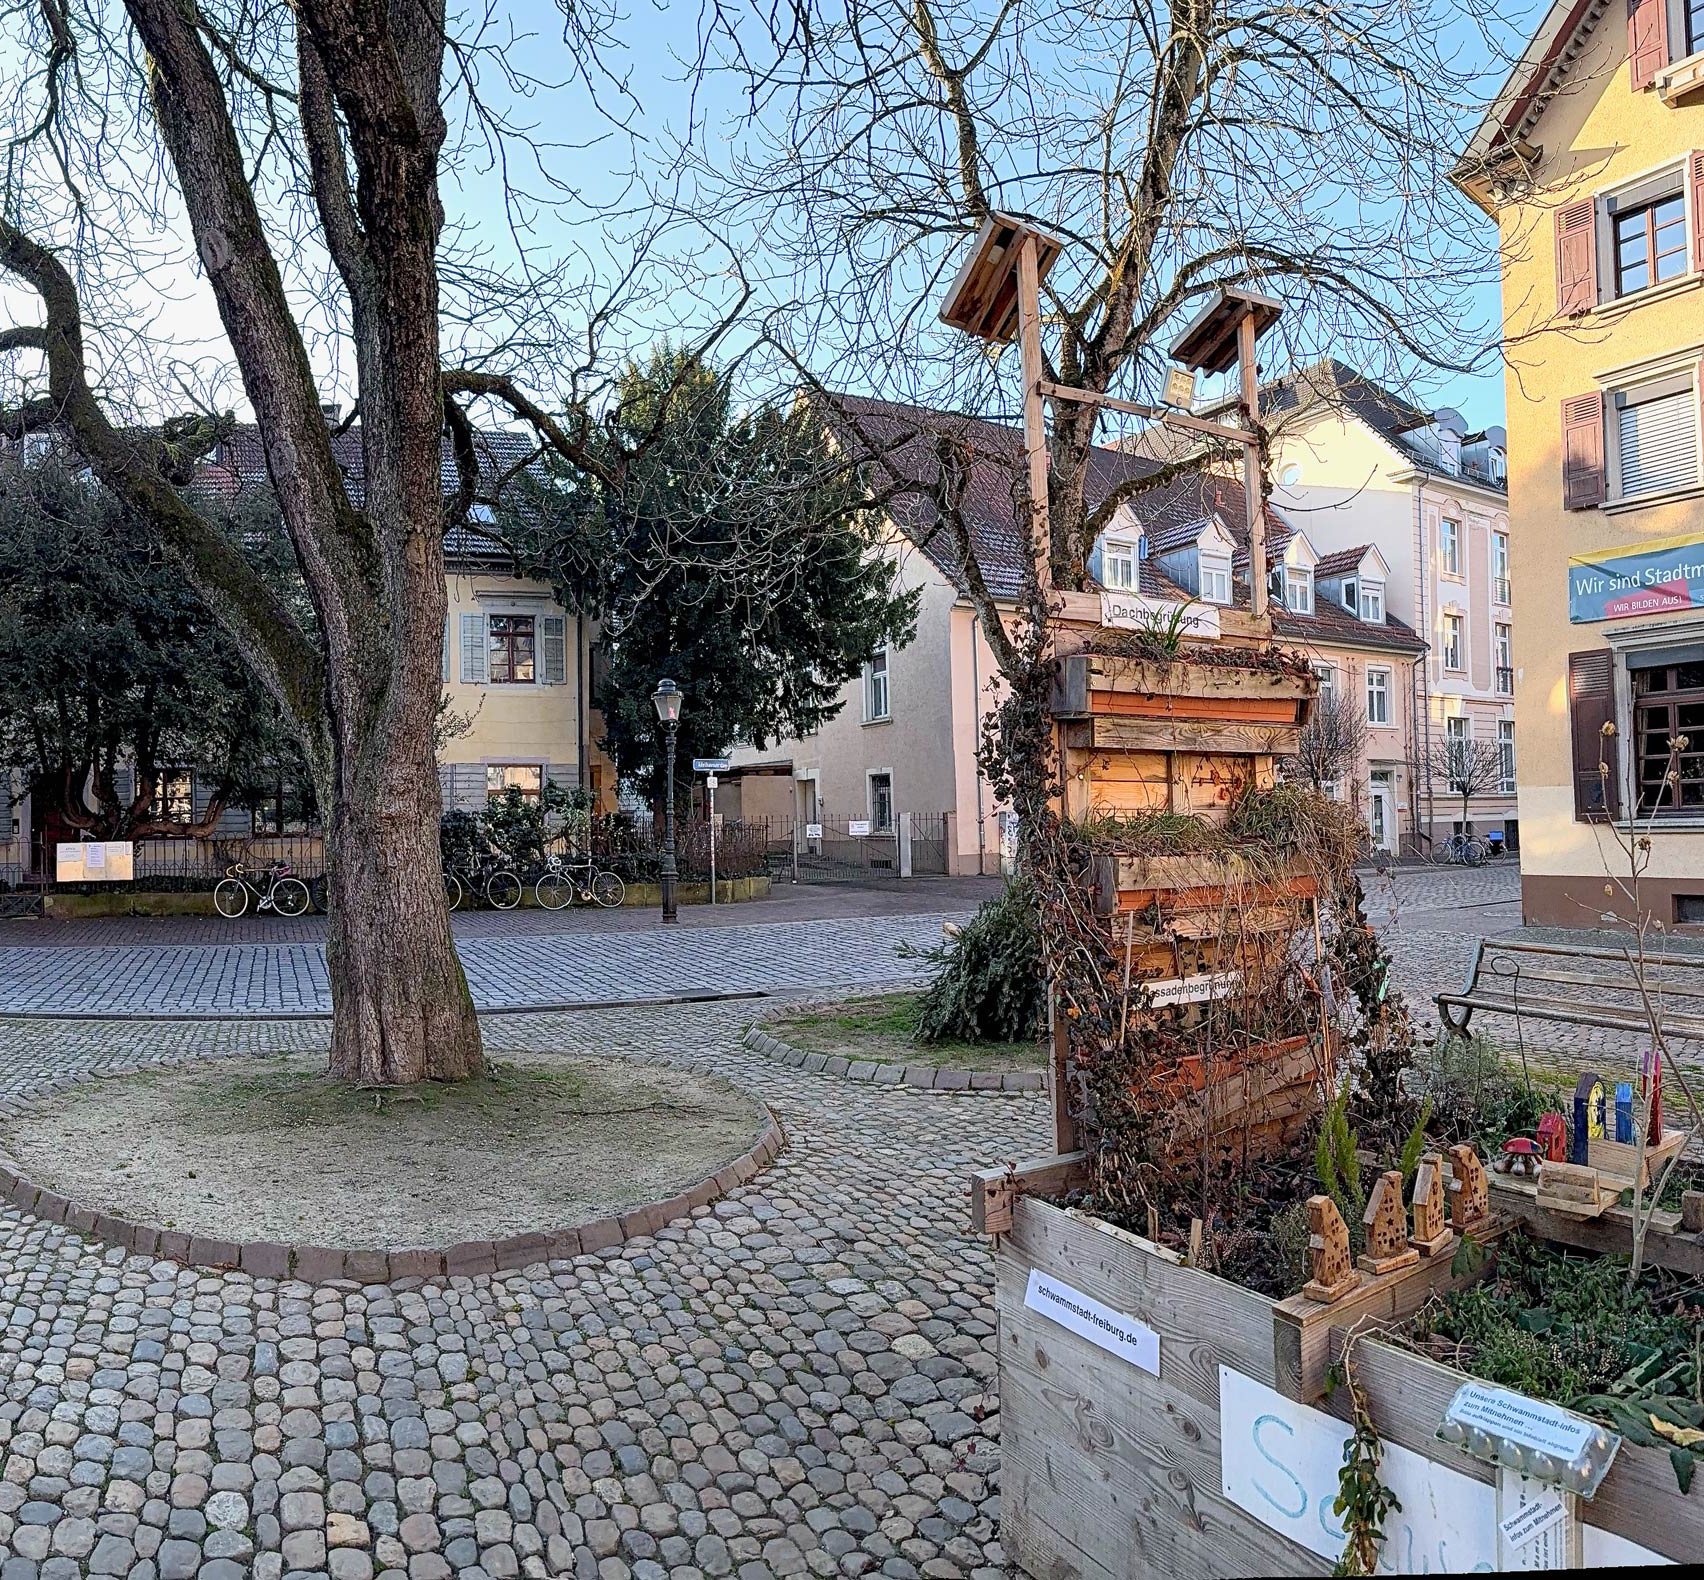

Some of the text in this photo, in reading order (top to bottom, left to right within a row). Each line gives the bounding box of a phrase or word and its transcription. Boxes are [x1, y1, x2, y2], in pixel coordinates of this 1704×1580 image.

[1576, 577, 1604, 596] Wir
[1609, 571, 1640, 591] sind
[1613, 603, 1629, 612] WIR
[1631, 600, 1659, 610] BILDEN
[1038, 1284, 1138, 1346] schwammstadt-freiburg.de
[1469, 1390, 1496, 1405] Unsere
[1463, 1400, 1480, 1411] zum
[1482, 1405, 1524, 1427] Mitnehmen
